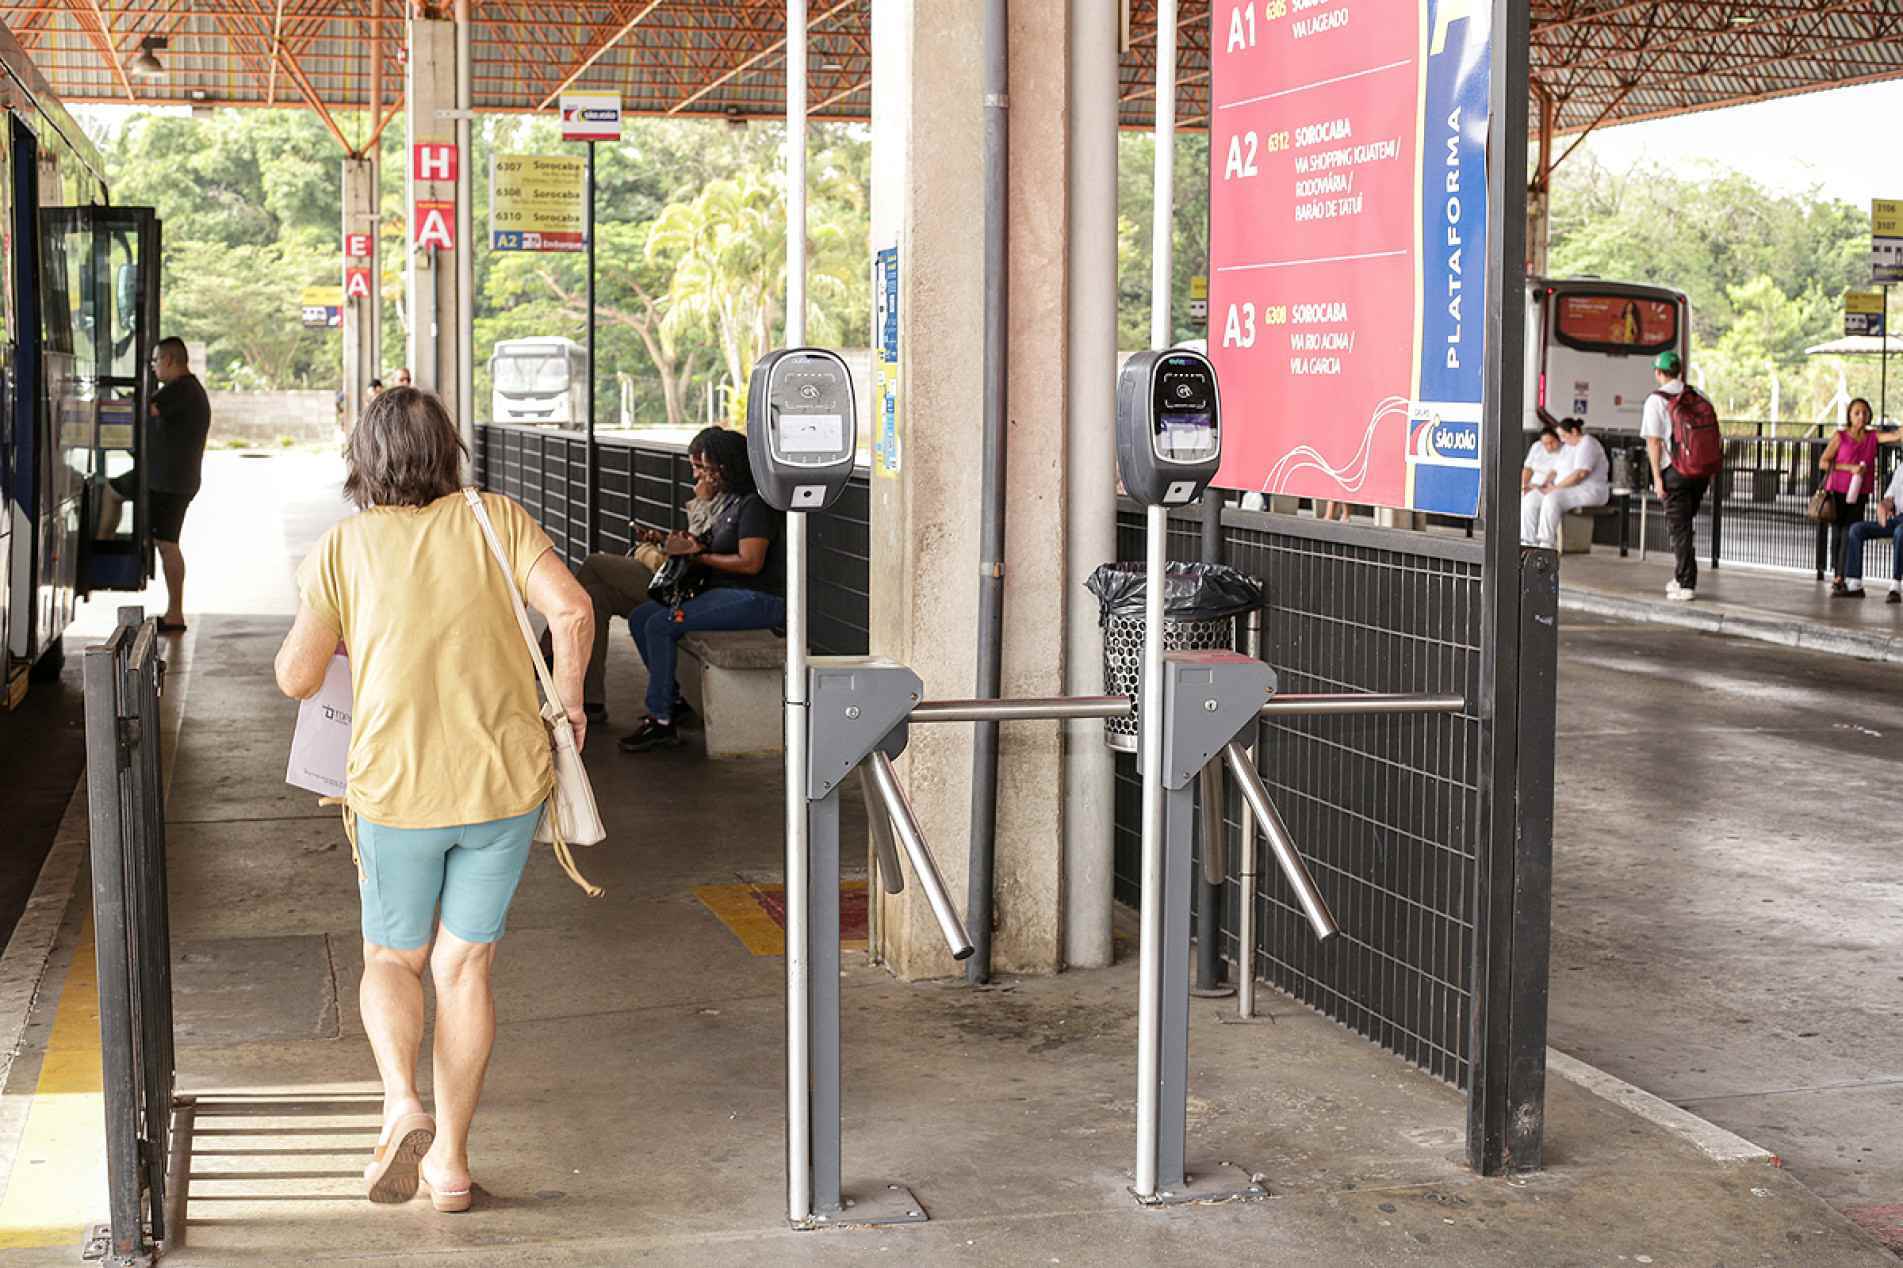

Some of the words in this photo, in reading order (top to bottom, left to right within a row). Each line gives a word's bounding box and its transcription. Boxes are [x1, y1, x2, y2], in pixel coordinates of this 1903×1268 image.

[1226, 1, 1257, 53] A1
[1292, 22, 1307, 39] VIA
[1307, 8, 1349, 35] LAGEADO
[1224, 131, 1259, 180] A2
[1267, 131, 1290, 152] 6312
[1295, 117, 1351, 147] SOROCABA
[1295, 156, 1309, 174] VIA
[1310, 148, 1352, 172] SHOPPING
[1353, 138, 1395, 165] IGUATEMI
[420, 147, 449, 178] H
[533, 160, 580, 171] Sorocaba
[533, 189, 580, 199] Sorocaba
[1295, 173, 1347, 197] RODOVIÁRIA
[533, 213, 580, 222] Sorocaba
[1295, 199, 1324, 221] BARÃO
[1325, 199, 1337, 218] DE
[1337, 192, 1363, 216] TATUÍ
[418, 209, 452, 248] A
[498, 233, 518, 248] A2
[1446, 105, 1462, 369] PLATAFORMA
[351, 236, 367, 256] E
[348, 272, 369, 296] A
[1222, 302, 1256, 349] A3
[1291, 302, 1347, 324] SOROCABA
[1290, 333, 1305, 351] VIA
[1305, 333, 1320, 351] RIO
[1320, 332, 1349, 351] ACIMA
[1290, 357, 1308, 375] VILA
[1309, 357, 1341, 375] GARCIA
